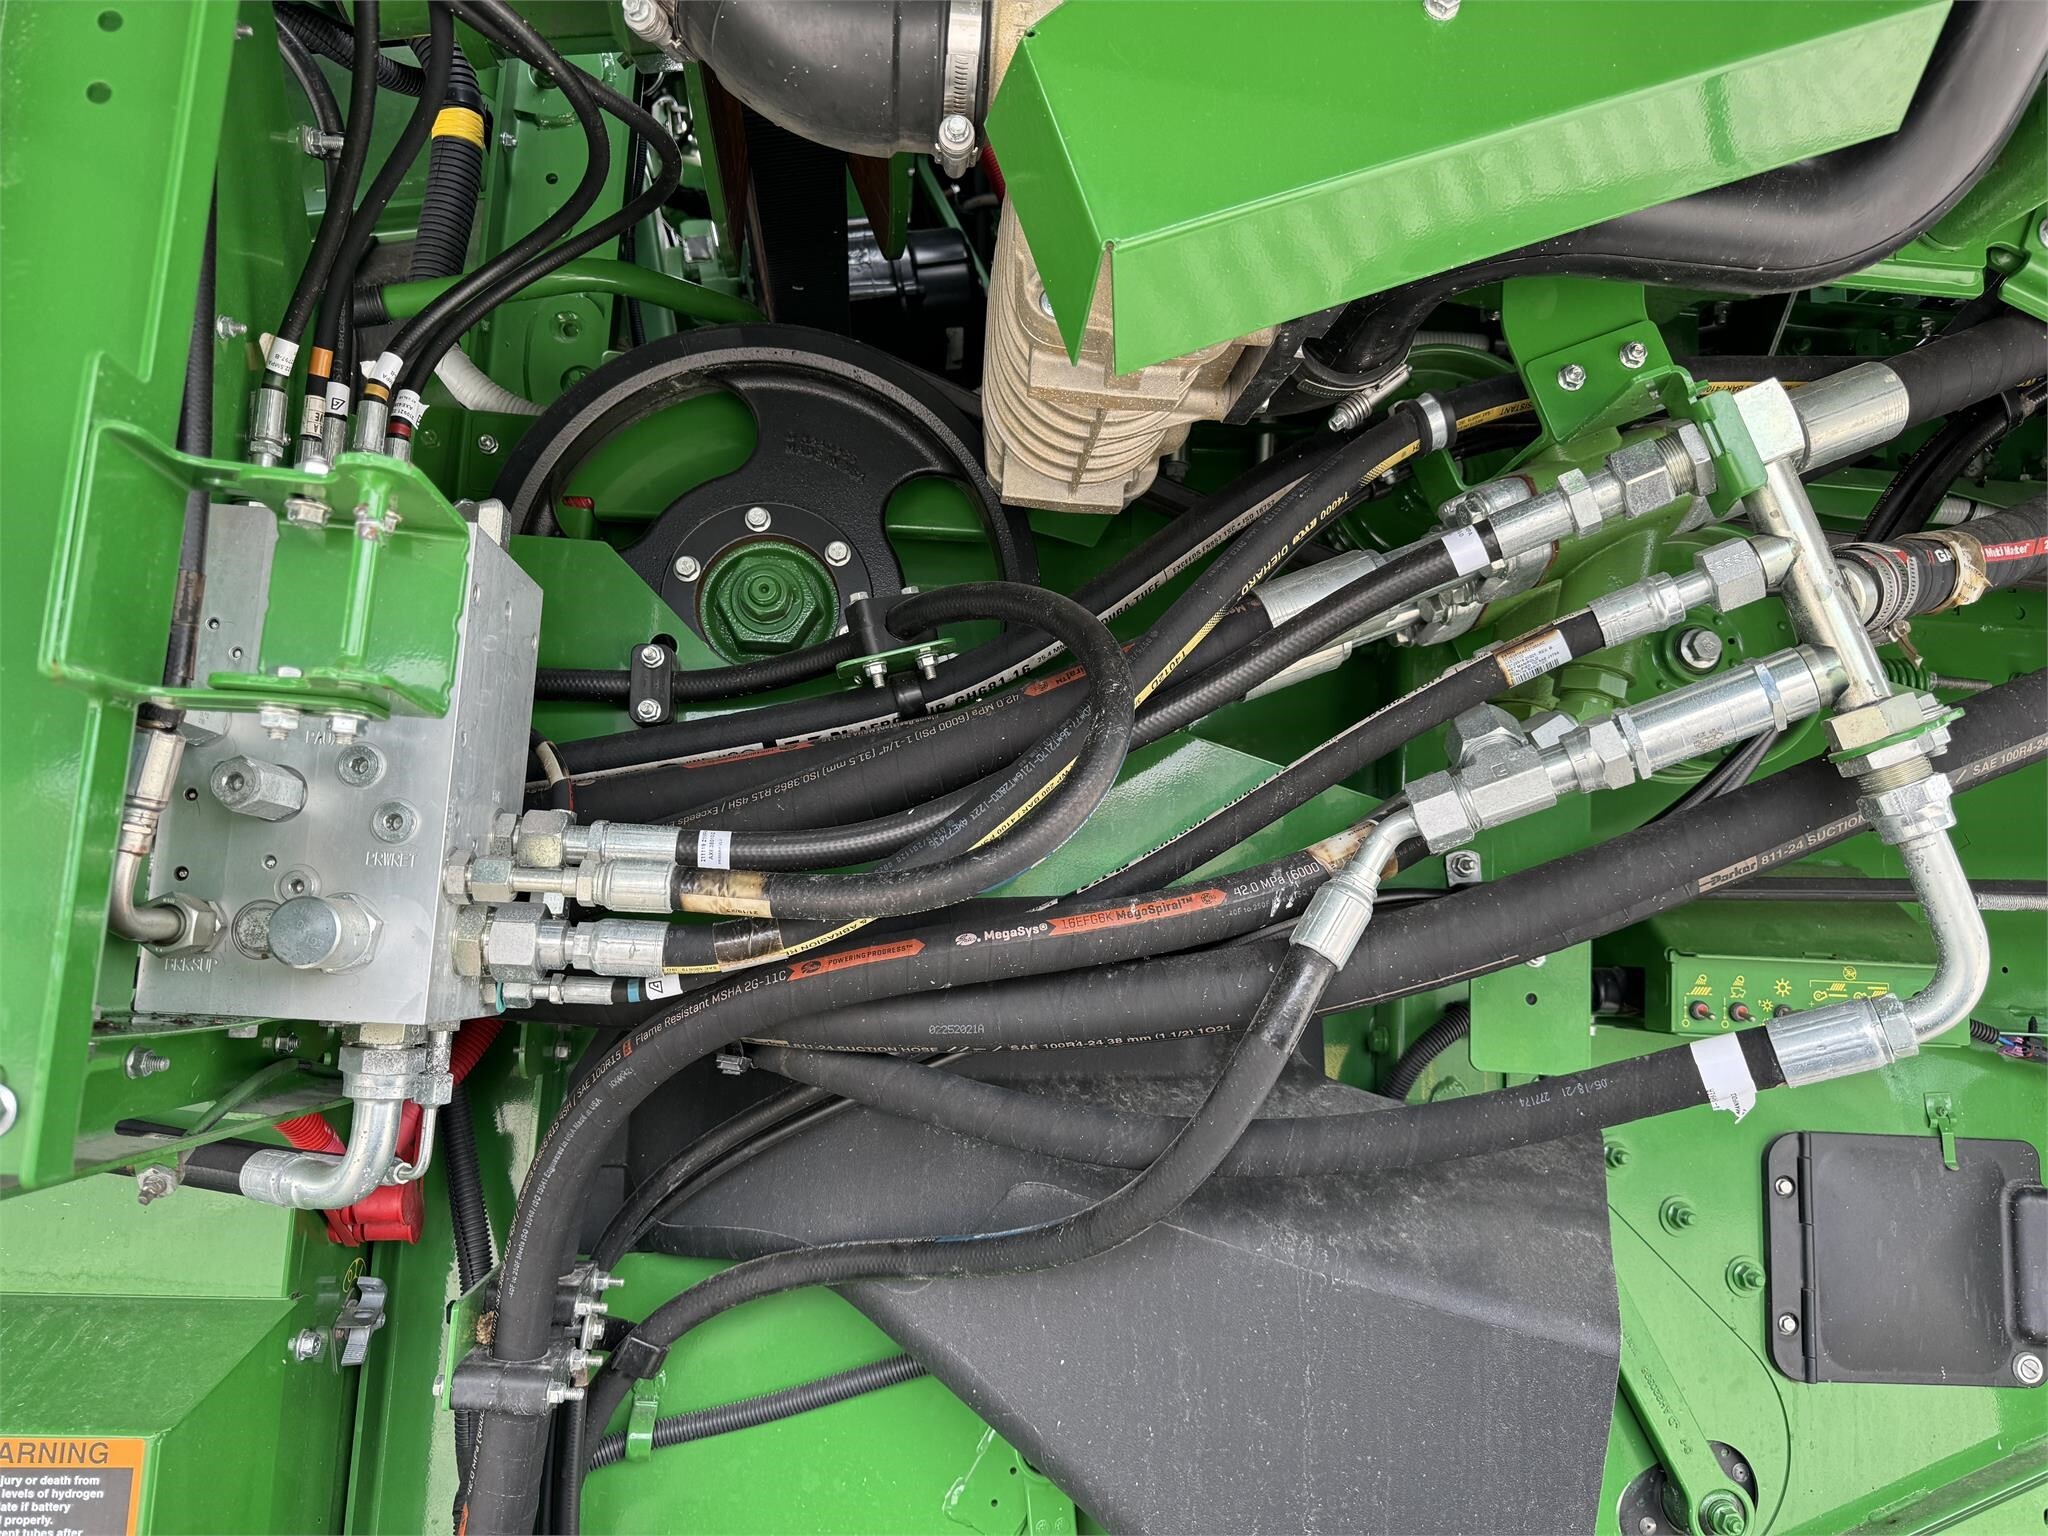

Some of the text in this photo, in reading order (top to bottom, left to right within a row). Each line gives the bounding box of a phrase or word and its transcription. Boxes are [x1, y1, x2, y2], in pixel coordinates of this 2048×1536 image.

[1315, 490, 1352, 520] T4000
[994, 692, 1020, 708] 42.0
[970, 702, 994, 716] MPa
[1970, 756, 2000, 775] SAE
[749, 785, 772, 801] R15
[726, 794, 749, 810] 4SH
[1707, 859, 1760, 886] Parker
[1758, 840, 1807, 866] 811-24
[1232, 881, 1259, 897] 42.0
[1260, 874, 1285, 889] MPa
[574, 1077, 593, 1098] SAE
[588, 1046, 623, 1085] 100R15
[631, 1020, 666, 1046] Flame
[660, 998, 713, 1029] Resistant
[709, 983, 744, 1007] MSHA
[742, 969, 789, 993] 2G-11C
[827, 949, 867, 968] POWERING
[1125, 1033, 1151, 1043] mm
[1196, 1023, 1231, 1034] 1Q21
[25, 1476, 37, 1485] or
[40, 1475, 71, 1485] death
[73, 1475, 100, 1485] from
[1, 1488, 104, 1500] levels of hydrogen
[20, 1501, 29, 1511] if
[31, 1502, 71, 1513] battery
[3, 1515, 53, 1527] properly.
[22, 1528, 54, 1536] tubes
[56, 1528, 83, 1536] after
